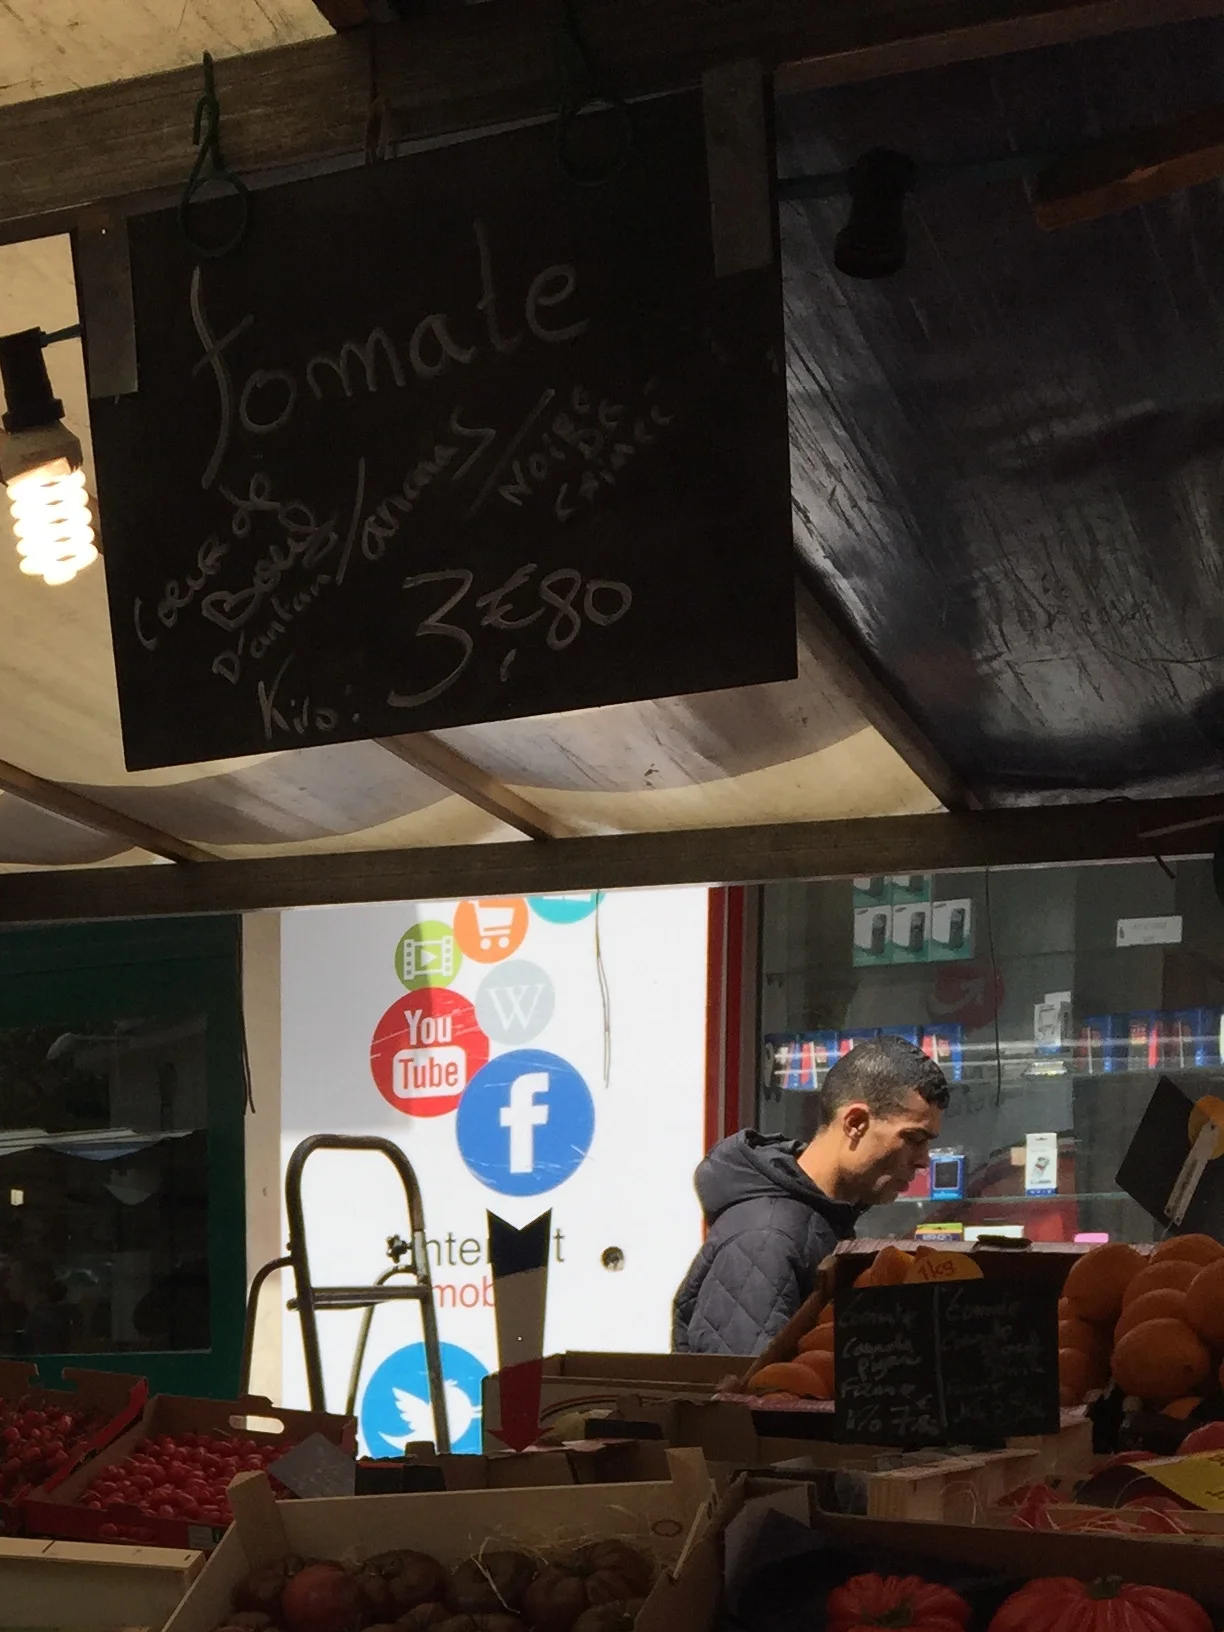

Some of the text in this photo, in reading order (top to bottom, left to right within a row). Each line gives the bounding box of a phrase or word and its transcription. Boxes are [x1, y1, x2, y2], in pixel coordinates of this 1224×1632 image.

[404, 1009, 452, 1045] You
[399, 1057, 458, 1090] Tube
[500, 1072, 549, 1174] f
